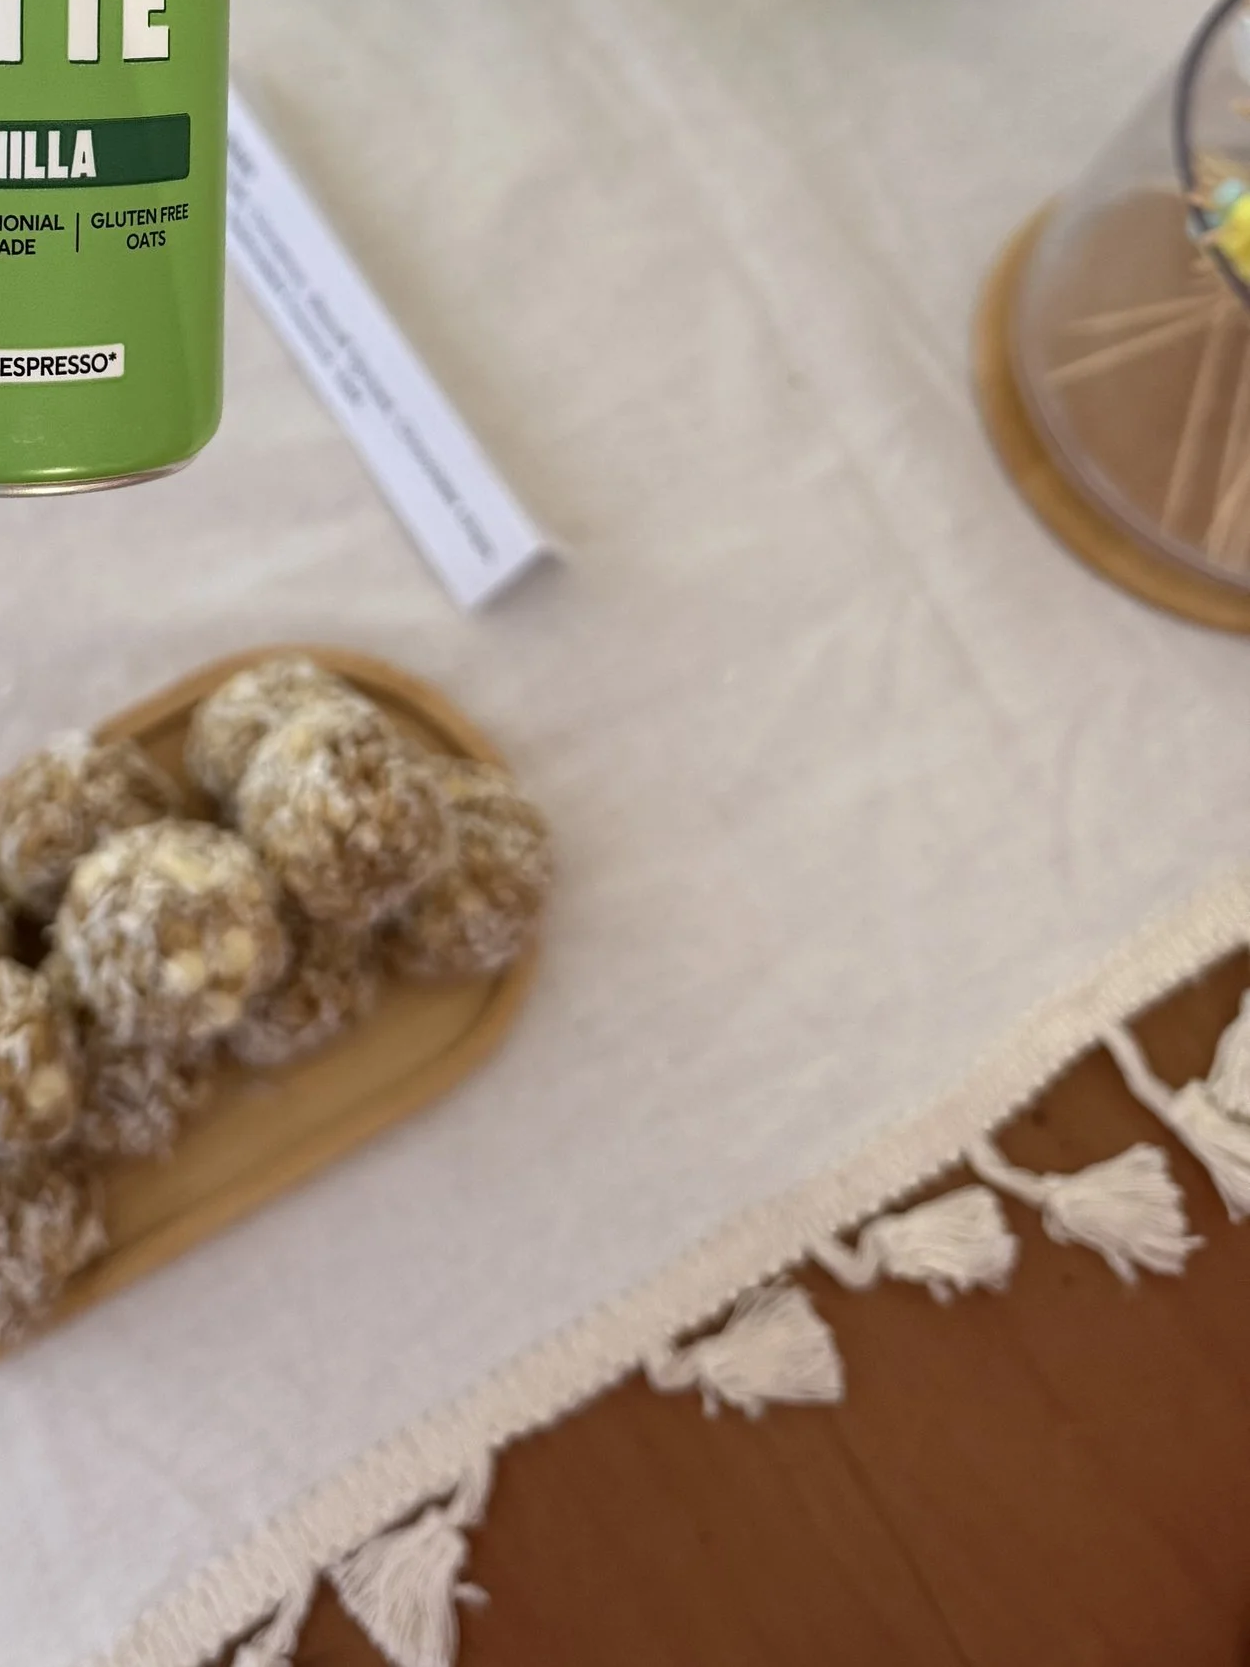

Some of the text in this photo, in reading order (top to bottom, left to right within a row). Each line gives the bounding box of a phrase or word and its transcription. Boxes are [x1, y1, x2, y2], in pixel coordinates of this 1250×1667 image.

[90, 203, 190, 230] GLUTEN FREE
[126, 231, 167, 250] OATS
